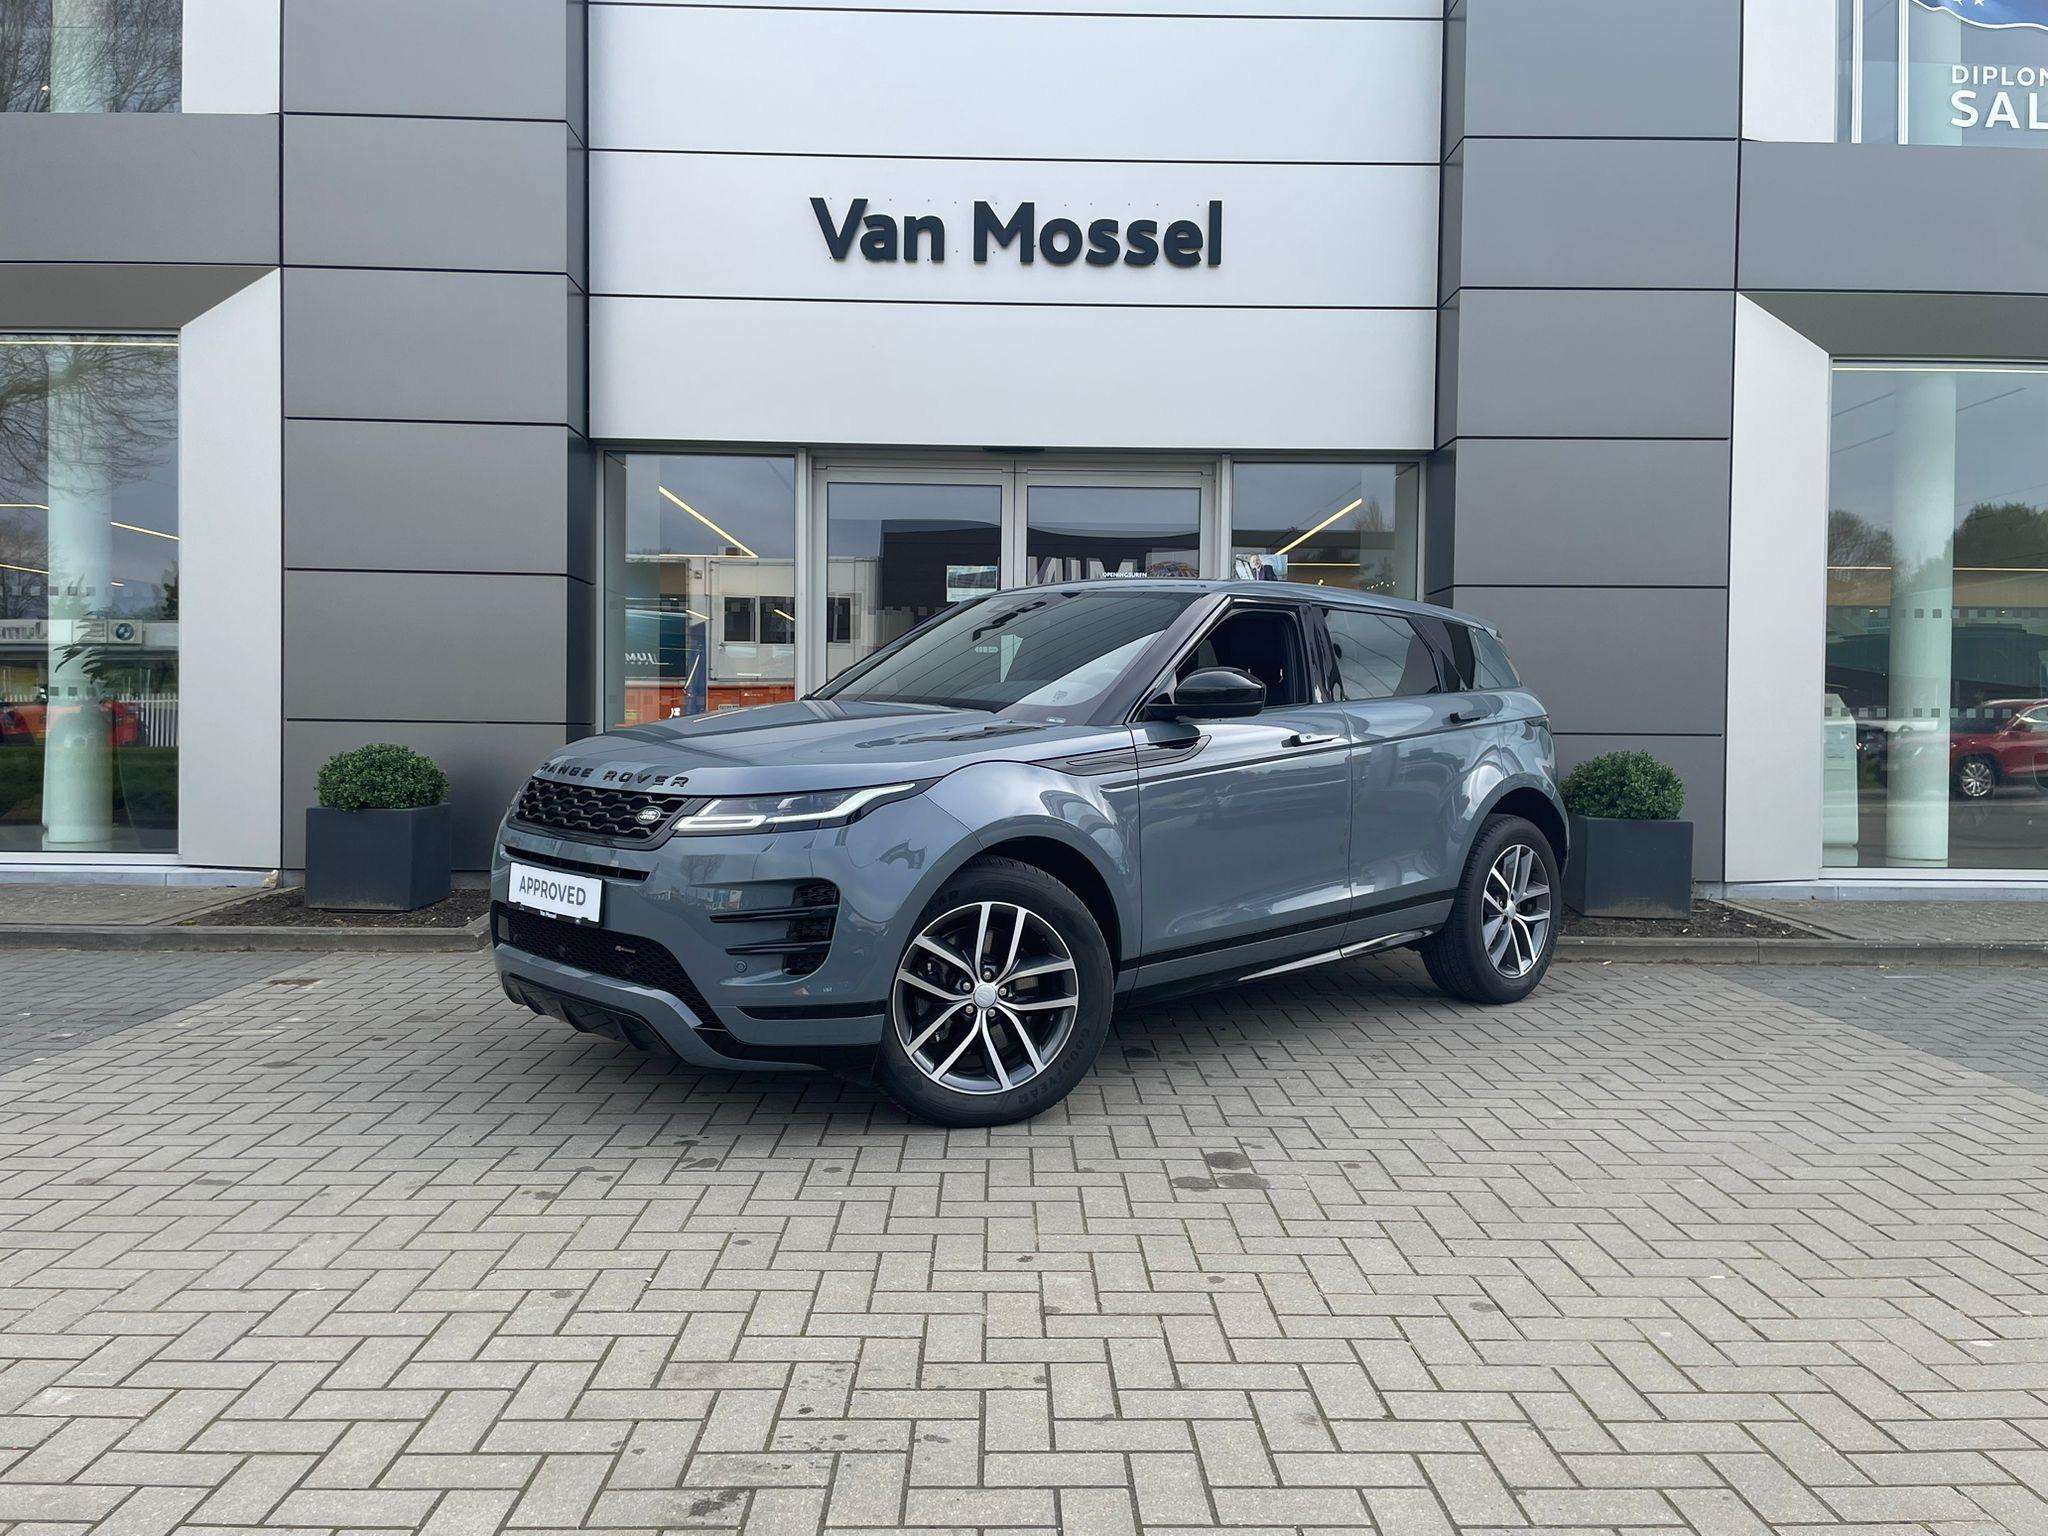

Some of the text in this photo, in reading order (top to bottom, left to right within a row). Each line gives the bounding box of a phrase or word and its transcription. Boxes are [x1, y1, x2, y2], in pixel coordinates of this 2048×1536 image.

[809, 197, 1222, 267] Van Mossel
[540, 763, 690, 788] RANGE ROVER
[519, 875, 586, 906] APPROVED
